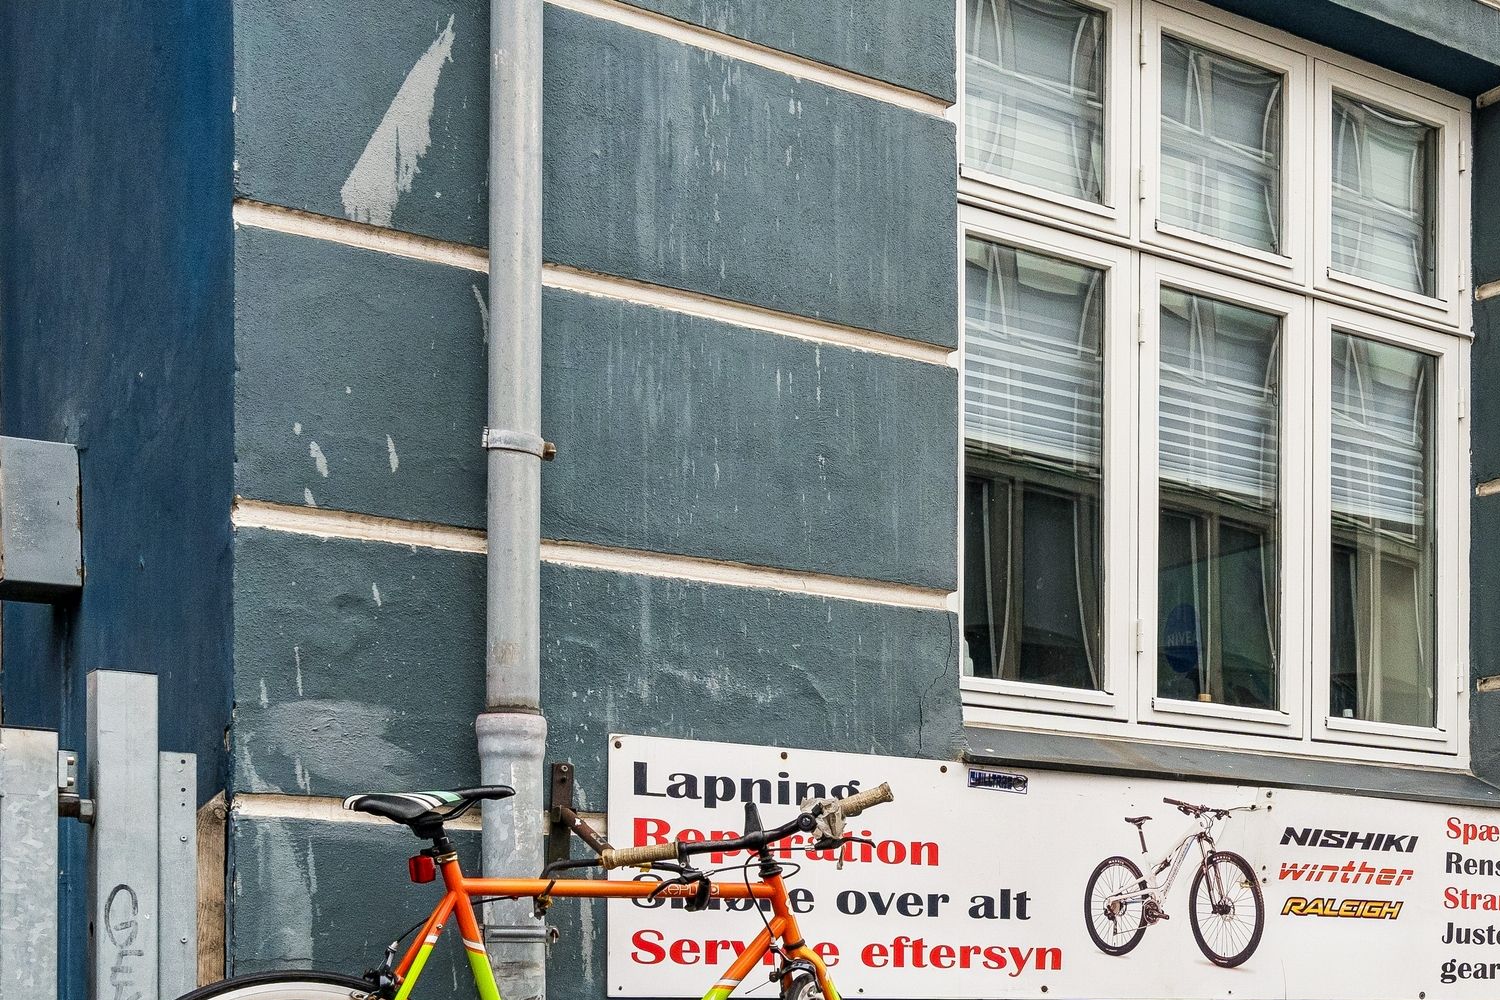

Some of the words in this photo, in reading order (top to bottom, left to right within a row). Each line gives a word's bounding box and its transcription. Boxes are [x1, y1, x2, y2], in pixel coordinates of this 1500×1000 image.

[1280, 826, 1419, 853] NISHIKI
[1279, 860, 1414, 886] winther
[836, 890, 950, 918] over
[968, 889, 1031, 920] alt
[1280, 896, 1404, 920] RALEIGH
[631, 929, 840, 967] Serve
[861, 936, 1062, 977] eftersyn
[1440, 958, 1500, 984] gear
